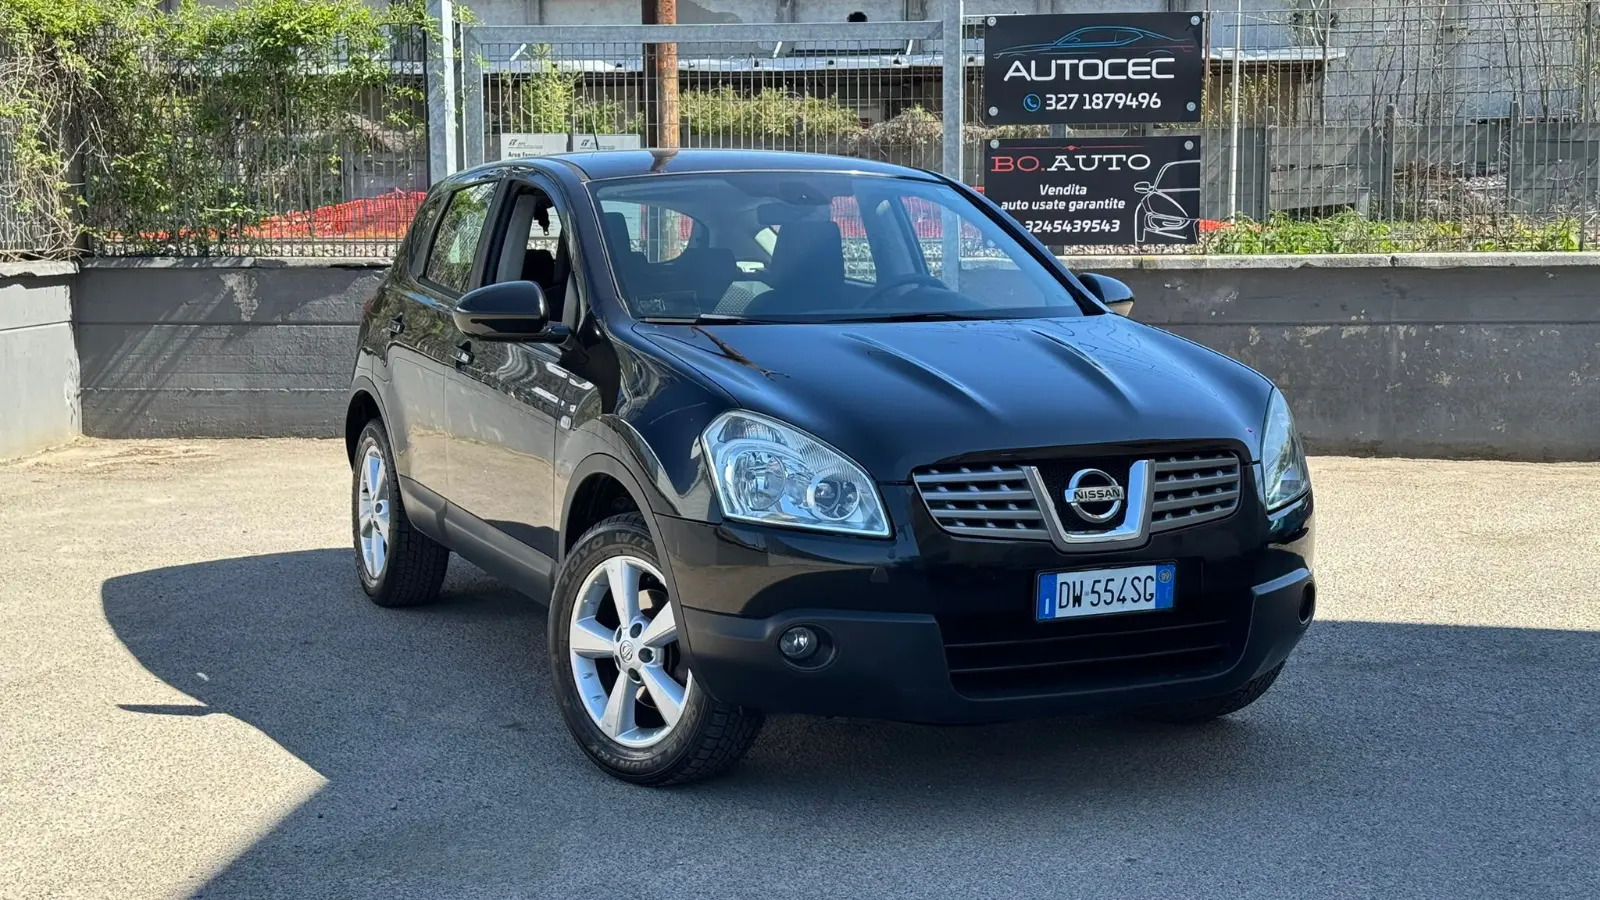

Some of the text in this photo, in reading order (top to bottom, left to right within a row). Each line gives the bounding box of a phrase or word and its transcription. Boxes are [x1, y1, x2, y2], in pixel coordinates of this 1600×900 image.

[1003, 57, 1175, 82] AUTOCEC
[1045, 92, 1162, 110] 327 1879496
[990, 153, 1151, 172] BO.AUTO
[1039, 184, 1087, 196] Vendita
[1001, 199, 1126, 211] auto usate garantite
[1025, 220, 1121, 233] 3245439543
[1074, 489, 1120, 499] NISSAN
